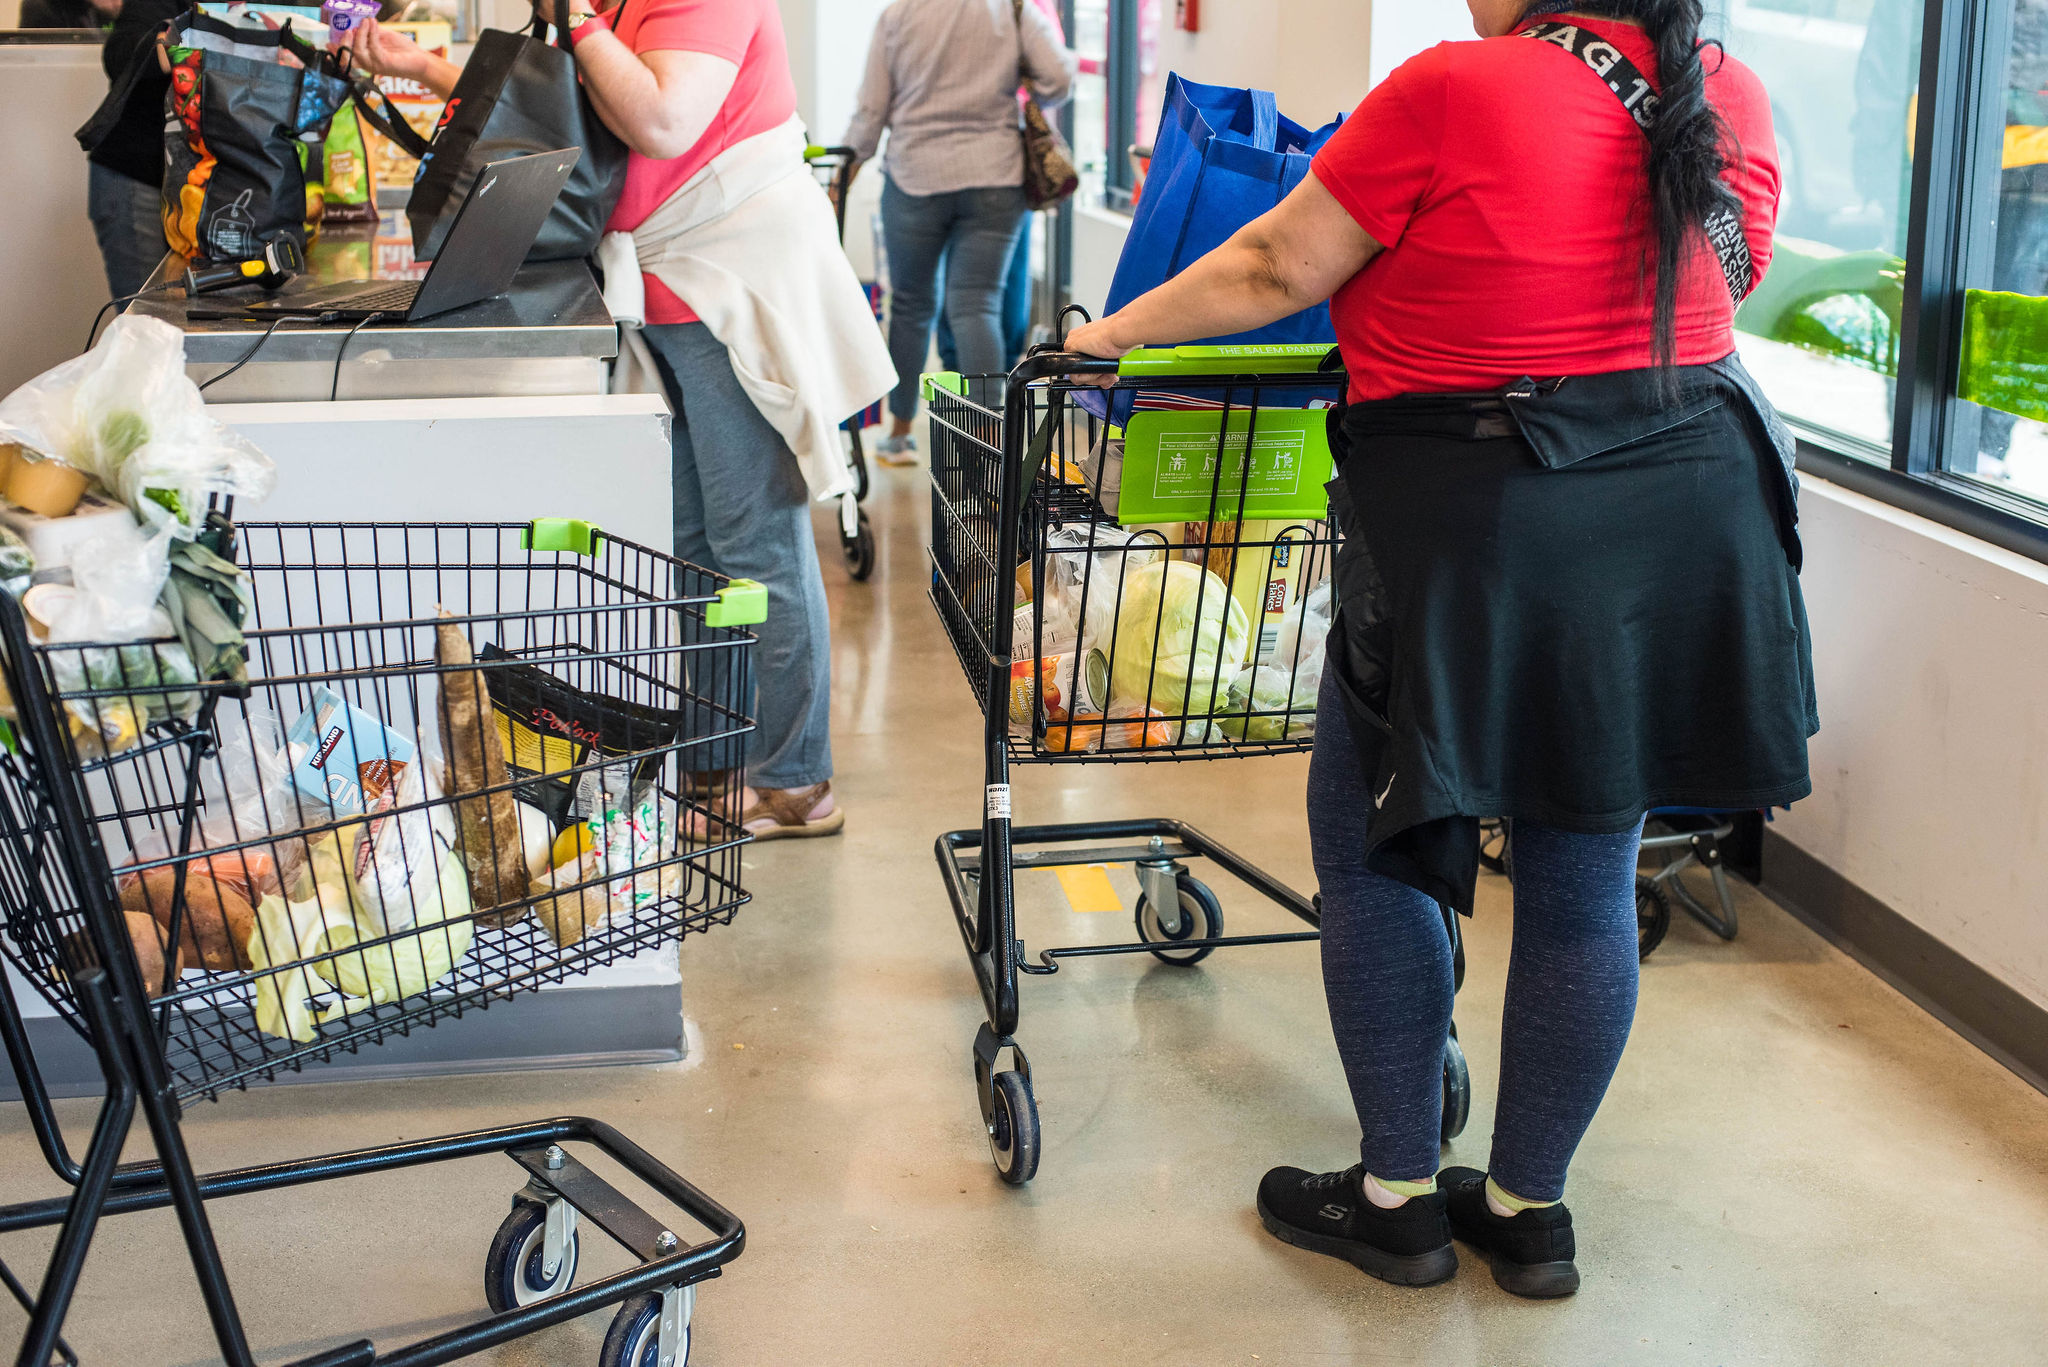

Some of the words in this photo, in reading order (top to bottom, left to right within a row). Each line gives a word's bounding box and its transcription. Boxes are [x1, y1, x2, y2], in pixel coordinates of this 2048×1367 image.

[1217, 347, 1242, 355] THE
[1243, 345, 1285, 355] SALEM
[1286, 345, 1331, 354] PANTRY
[1219, 433, 1257, 442] ARNING
[1267, 582, 1278, 611] Flakes
[1274, 583, 1285, 608] Corn
